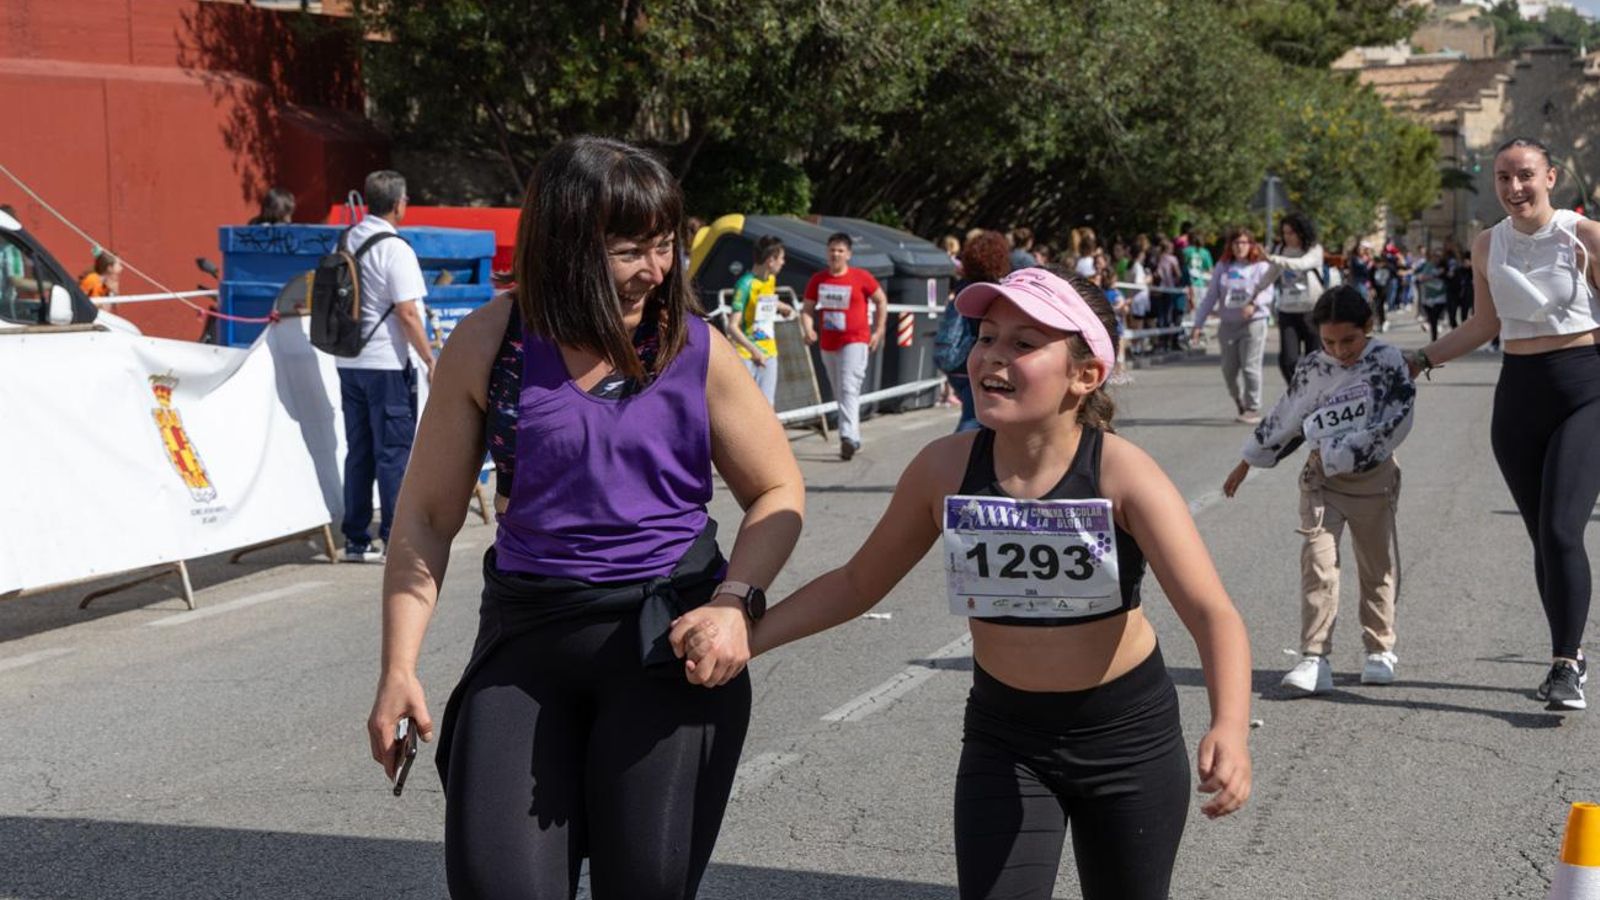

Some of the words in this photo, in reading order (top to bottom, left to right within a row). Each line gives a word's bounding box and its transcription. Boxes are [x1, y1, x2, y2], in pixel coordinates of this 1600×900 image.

[1313, 403, 1365, 429] 1344
[1037, 518, 1049, 528] LA
[966, 542, 1094, 580] 1293
